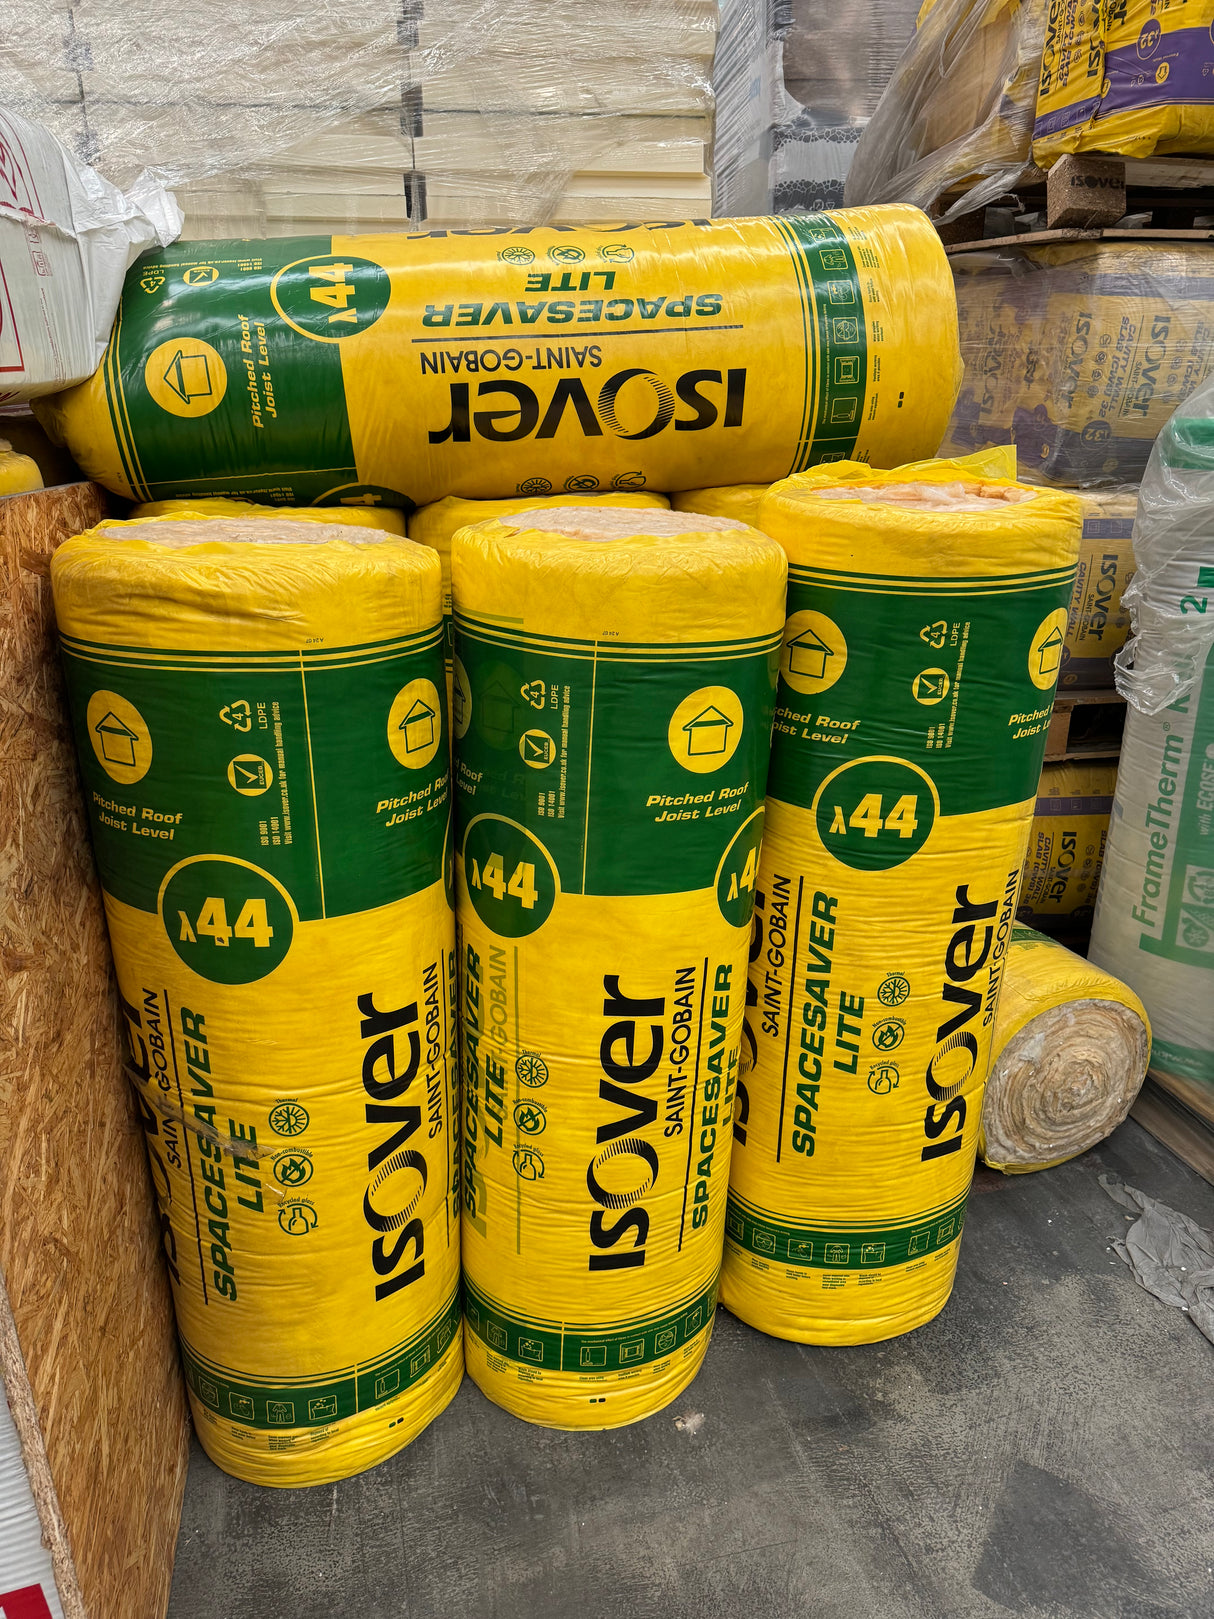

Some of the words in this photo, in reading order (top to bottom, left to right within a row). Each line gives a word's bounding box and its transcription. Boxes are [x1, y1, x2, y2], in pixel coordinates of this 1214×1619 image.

[524, 271, 616, 292] LITE
[422, 293, 723, 327] SPACESAVER
[237, 314, 252, 354] Roof
[253, 322, 270, 367] Level
[1116, 317, 1130, 353] SLAB
[1120, 324, 1136, 374] CAVITY
[420, 345, 603, 375] SAINT-GOBAIN
[242, 358, 265, 429] Pitched
[262, 372, 278, 419] Joist
[1073, 562, 1087, 605] CAVITY
[949, 622, 961, 647] LDPE
[1066, 606, 1079, 637] WALL
[550, 684, 559, 710] LDPE
[256, 702, 268, 730] LDPE
[770, 720, 797, 737] oist
[801, 727, 849, 745] Level
[815, 714, 861, 731] Roof
[1008, 708, 1050, 726] Pitched
[1012, 725, 1041, 740] Joist
[460, 762, 484, 783] Roof
[92, 791, 137, 818] Pitched
[141, 807, 183, 825] Roof
[375, 783, 432, 814] Pitched
[645, 790, 716, 808] Pitched
[718, 781, 750, 802] Roof
[654, 807, 700, 823] Joist
[704, 799, 742, 819] Level
[99, 811, 128, 832] Joist
[131, 822, 175, 841] Level
[385, 805, 424, 828] Joist
[761, 874, 792, 1037] SAINT-GOBAIN
[983, 869, 1020, 1028] SAINT-GOBAIN
[792, 890, 839, 1158] SPACESAVER
[833, 990, 865, 1075] LITE
[423, 961, 443, 1140] SAINT-GOBAIN
[664, 966, 697, 1138] SAINT-GOBAIN
[463, 943, 482, 1219] SPACESAVER
[692, 963, 734, 1231] SPACESAVER
[722, 1045, 739, 1128] LITE
[485, 1054, 505, 1148] LITE
[180, 1006, 238, 1302] SPACESAVER
[229, 1118, 265, 1213] LITE
